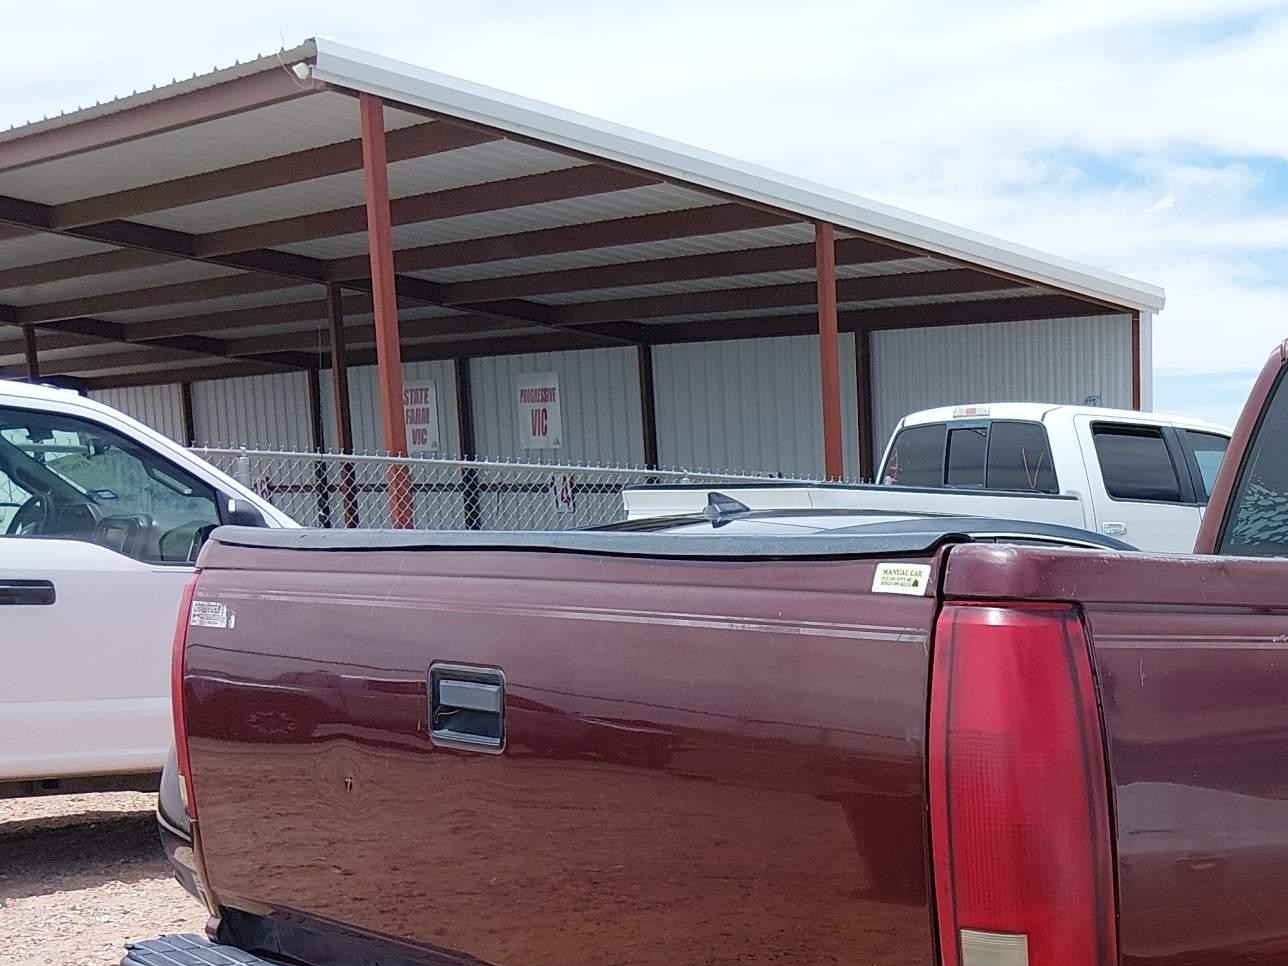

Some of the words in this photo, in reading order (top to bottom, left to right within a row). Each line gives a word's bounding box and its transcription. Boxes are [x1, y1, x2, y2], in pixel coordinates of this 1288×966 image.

[403, 387, 430, 406] STATE
[519, 387, 557, 404] PROGRESSIVE
[405, 408, 430, 425] FARM
[530, 408, 548, 437] VIC
[411, 428, 428, 446] VIC
[882, 568, 909, 576] MANUAL
